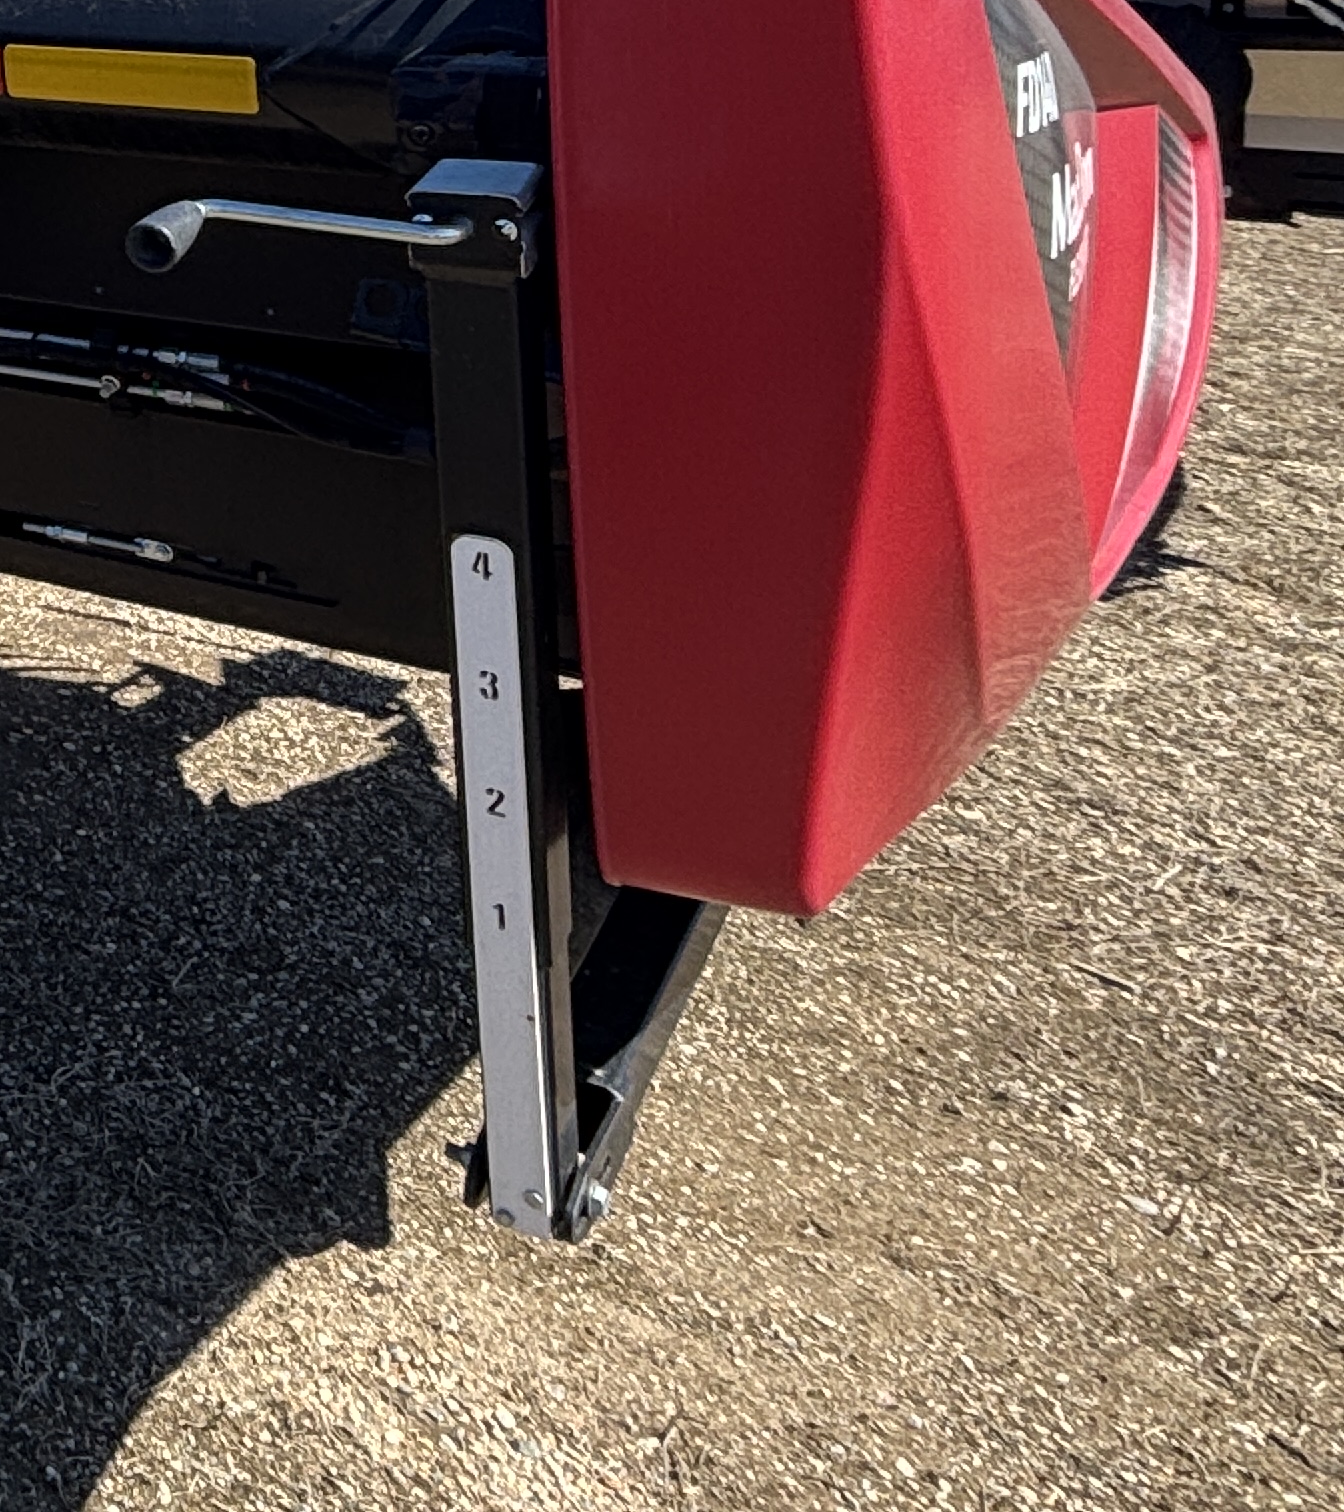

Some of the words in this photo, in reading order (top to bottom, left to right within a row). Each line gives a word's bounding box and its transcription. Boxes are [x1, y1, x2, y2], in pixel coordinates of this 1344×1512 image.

[472, 551, 492, 581] 4
[479, 670, 499, 701] 3
[485, 787, 506, 818] 2
[493, 903, 506, 931] 1
